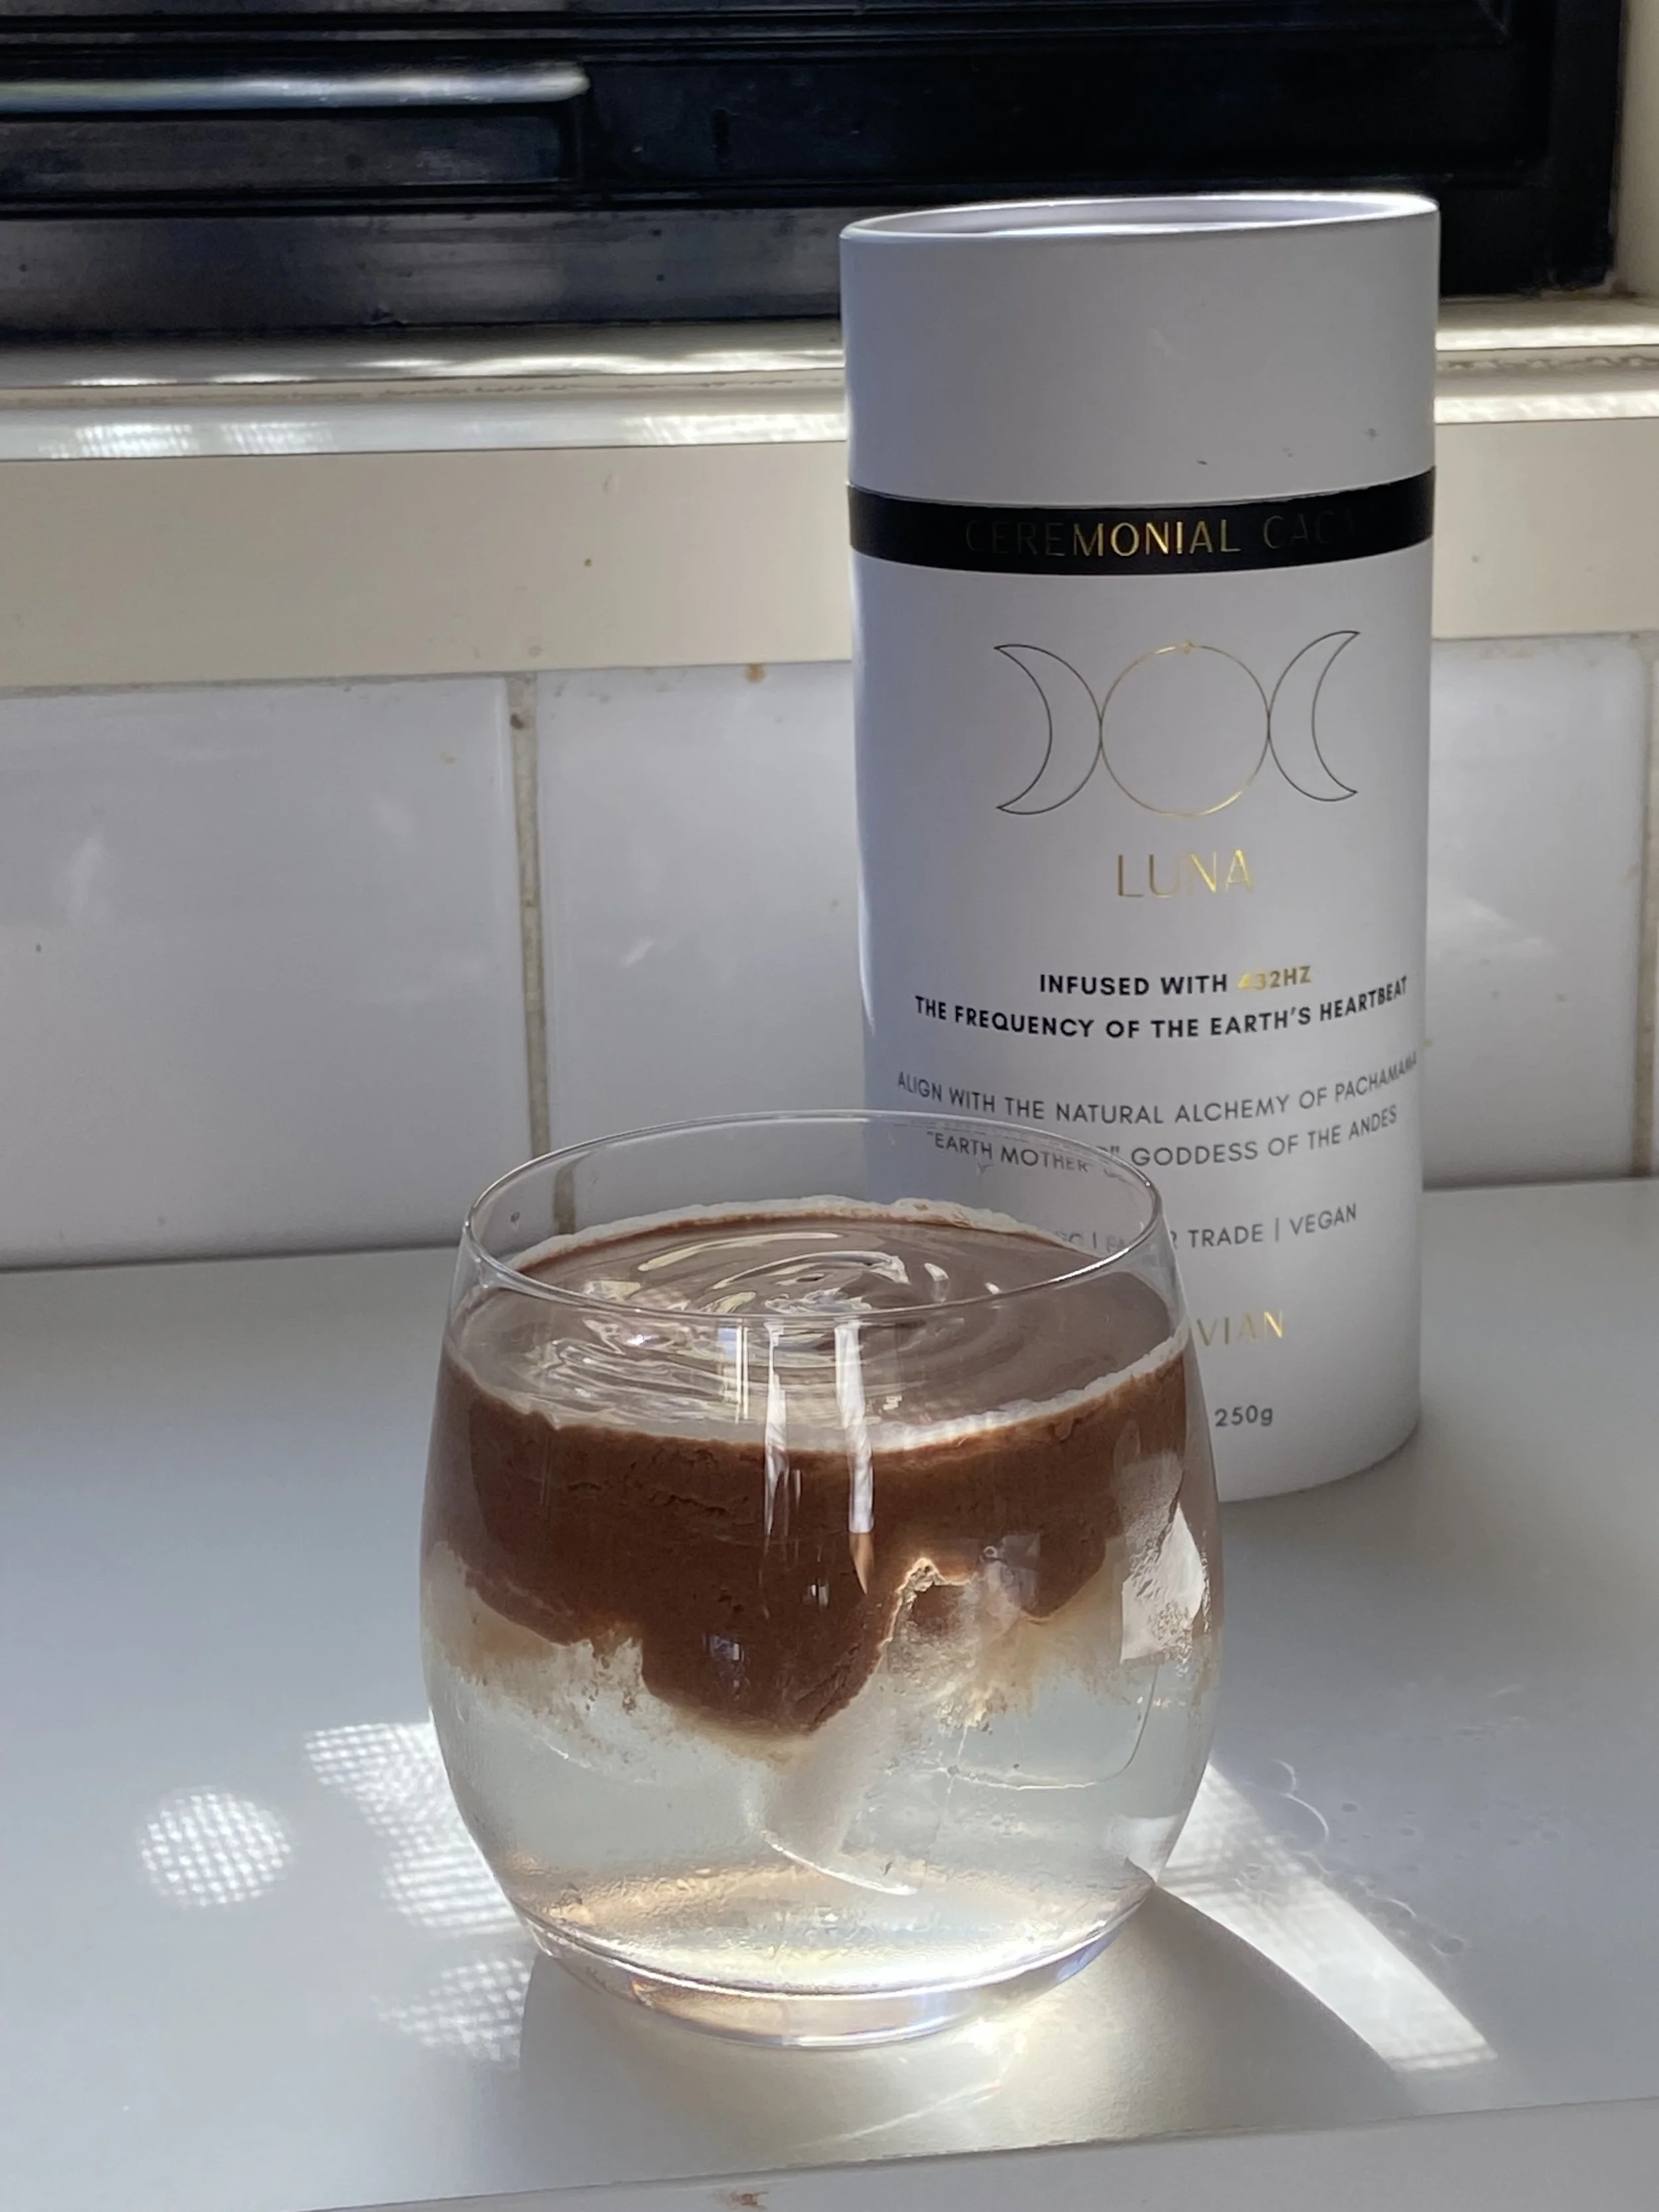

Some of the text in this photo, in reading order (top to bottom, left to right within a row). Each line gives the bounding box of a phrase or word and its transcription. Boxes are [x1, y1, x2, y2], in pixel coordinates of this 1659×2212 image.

[966, 519, 1240, 557] CEREMONIAL
[1118, 849, 1252, 897] LUNA
[915, 975, 1407, 1039] THE FREQUENCY OF THE EARTH'S HEARTBEAT
[1040, 974, 1149, 995] INFUSED
[1161, 974, 1228, 995] WITH
[897, 1071, 942, 1102] ALIGN
[949, 1086, 995, 1113] WITH
[1004, 1097, 1045, 1120] THE
[1056, 1103, 1164, 1124] NATURAL
[1175, 1094, 1289, 1124] ALCHEMY
[1299, 1086, 1328, 1110] OF
[1131, 1141, 1258, 1166] GODDESS
[1267, 1134, 1299, 1157] OF
[1307, 1125, 1341, 1151] THE
[1348, 1104, 1397, 1141] ANDES
[1187, 1223, 1263, 1248] TRADE
[1289, 1203, 1356, 1236] VEGAN
[1196, 1311, 1284, 1347] VIAN
[1215, 1404, 1273, 1428] 250g
